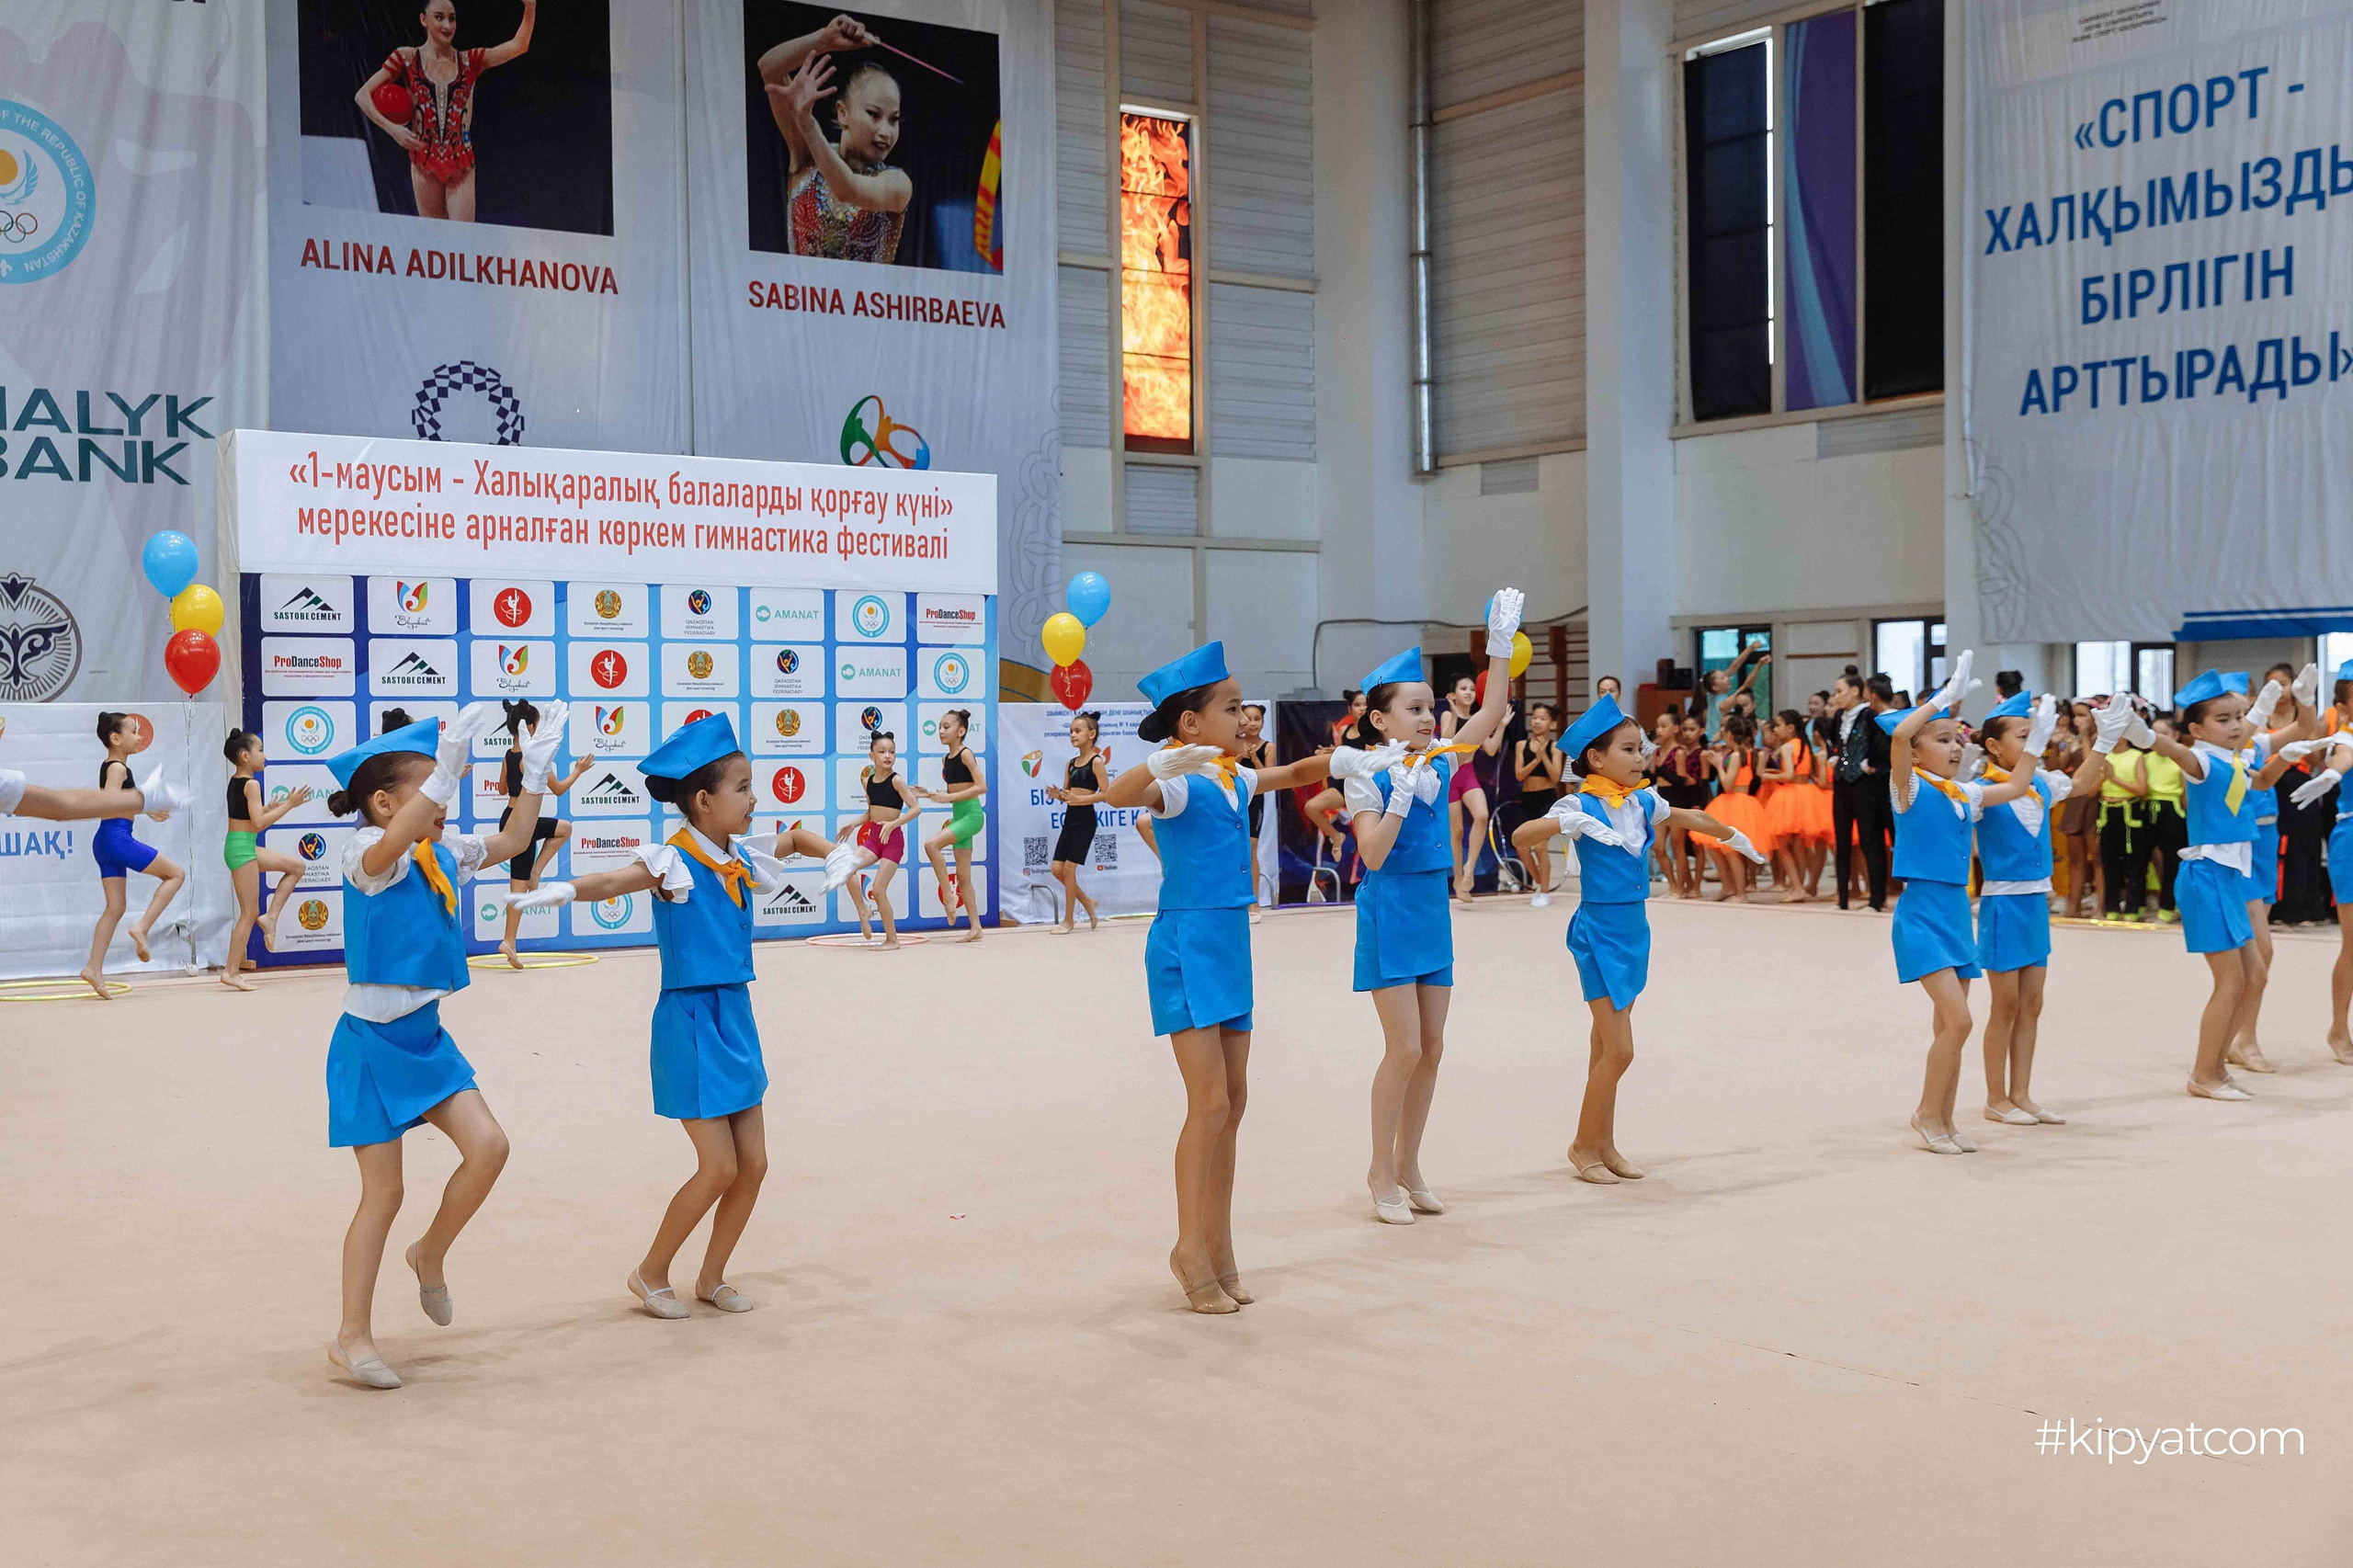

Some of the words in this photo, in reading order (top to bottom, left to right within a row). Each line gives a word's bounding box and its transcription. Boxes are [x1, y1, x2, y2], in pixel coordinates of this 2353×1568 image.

[14, 113, 40, 132] THE
[2075, 66, 2268, 151] «СПОРТ
[40, 128, 85, 188] REPUBLIC
[75, 191, 86, 210] OF
[24, 210, 85, 272] KAZAKHSTAN
[300, 237, 393, 276] ALINA
[404, 248, 619, 295] ADILKHANOVA
[748, 280, 846, 316] SABINA
[852, 290, 1006, 330] ASHIRBAEVA
[2081, 245, 2294, 325] БІРЛІГІН
[0, 386, 216, 439] ALYK
[290, 450, 442, 500] «1-маусым
[473, 459, 661, 510] Халықаралық
[668, 471, 802, 517] балаларды
[811, 487, 889, 526] қорғау
[896, 486, 954, 527] күні»
[298, 502, 455, 545] мерекесіне
[466, 509, 589, 550] арналған
[599, 518, 686, 555] көркем
[695, 524, 828, 554] гимнастика
[836, 528, 949, 562] фестивалі
[774, 609, 819, 620] AMANAT
[926, 608, 976, 621] ProDanceShop
[274, 655, 342, 670] ProDanceShop
[858, 667, 902, 678] AMANAT
[483, 737, 513, 746] SASTOB
[581, 836, 641, 850] ProDanceShop
